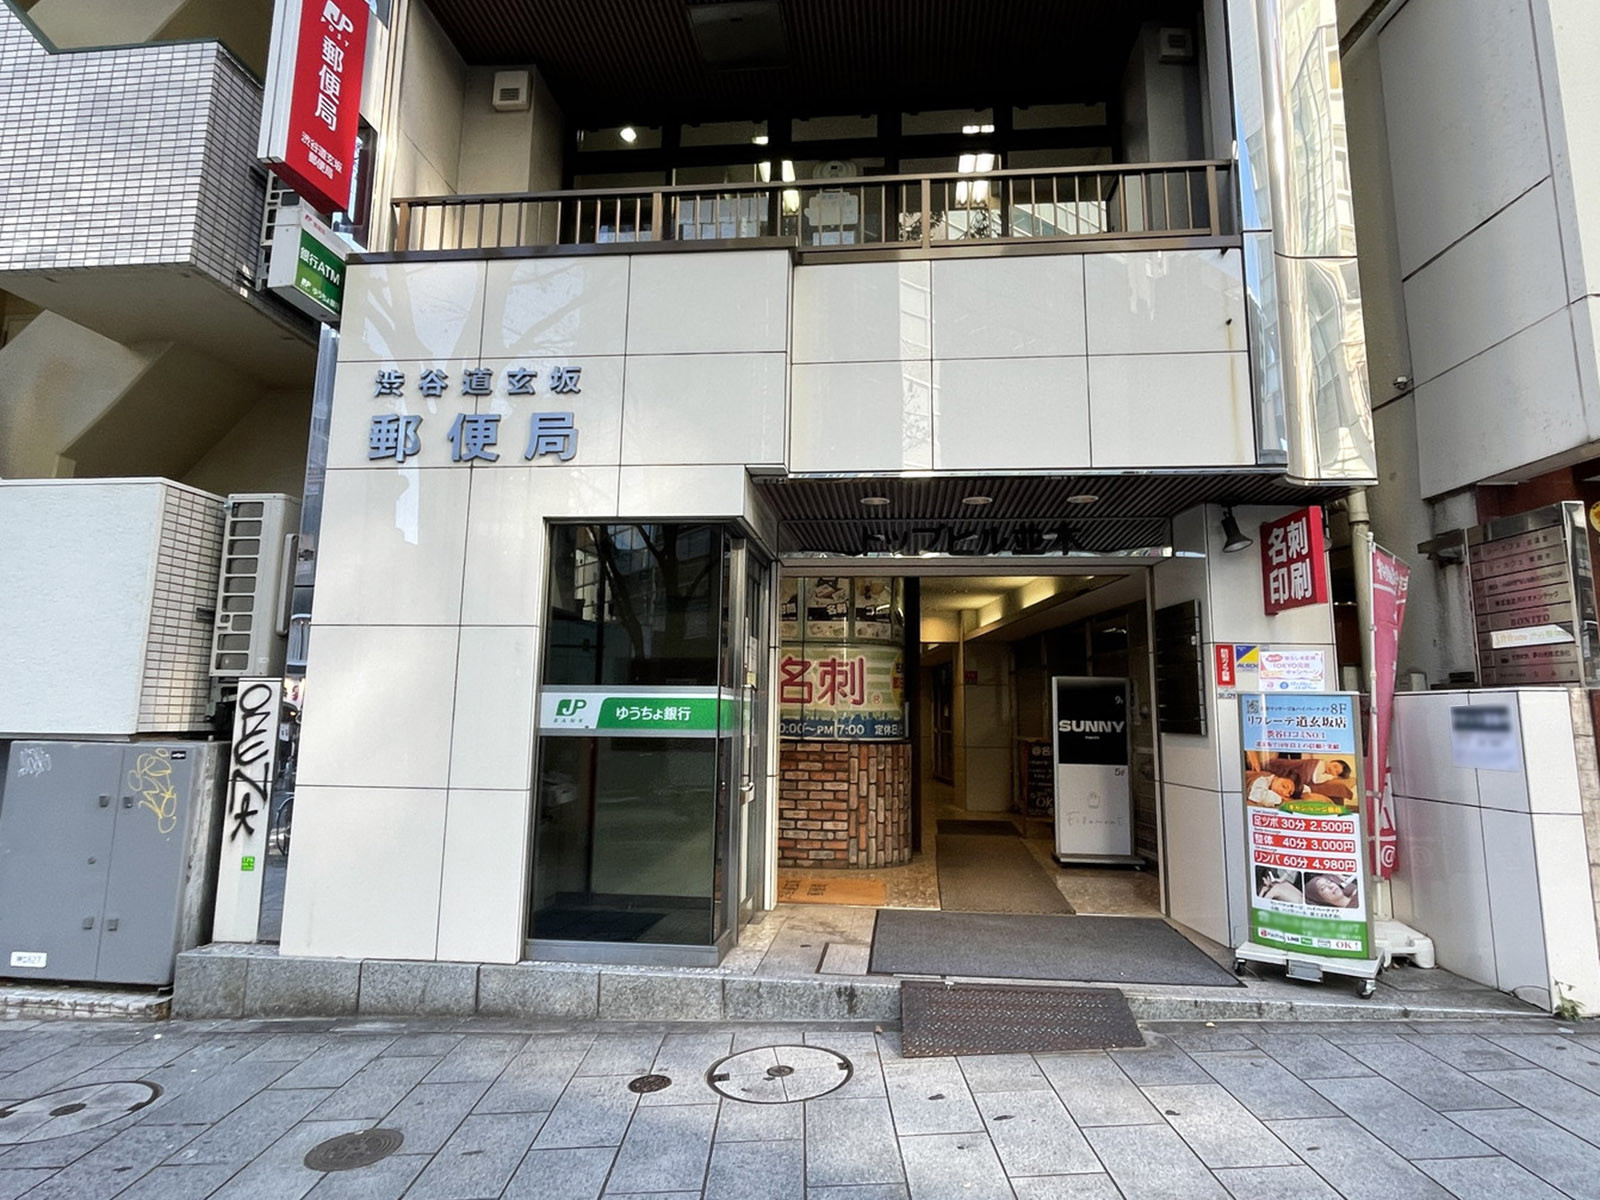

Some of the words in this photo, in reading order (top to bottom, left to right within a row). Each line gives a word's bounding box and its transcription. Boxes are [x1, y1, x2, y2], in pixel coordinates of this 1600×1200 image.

[315, 35, 344, 131] 郵便局
[301, 131, 343, 174] 渋谷道玄坂
[300, 246, 340, 286] 銀行ATM
[374, 366, 582, 398] 渋谷道玄坂
[369, 411, 579, 463] 郵便局
[1268, 517, 1309, 566] 名刺
[1269, 559, 1313, 604] 印刷
[1510, 614, 1550, 626] BONITO
[780, 656, 865, 706] 名刺
[556, 699, 587, 716] JP
[616, 706, 691, 721] ゆうちょ銀行
[1330, 703, 1347, 714] 8F
[1058, 720, 1125, 732] SUNNY
[1248, 716, 1347, 728] リフレーテ道玄坂店
[1281, 819, 1306, 831] 30分
[1310, 820, 1353, 833] 2.500円
[1254, 833, 1274, 845] 整体
[1282, 837, 1307, 849] 40分
[1311, 839, 1355, 852] 3.000円
[1283, 856, 1308, 869] 60分
[1312, 859, 1356, 872] 4.980円
